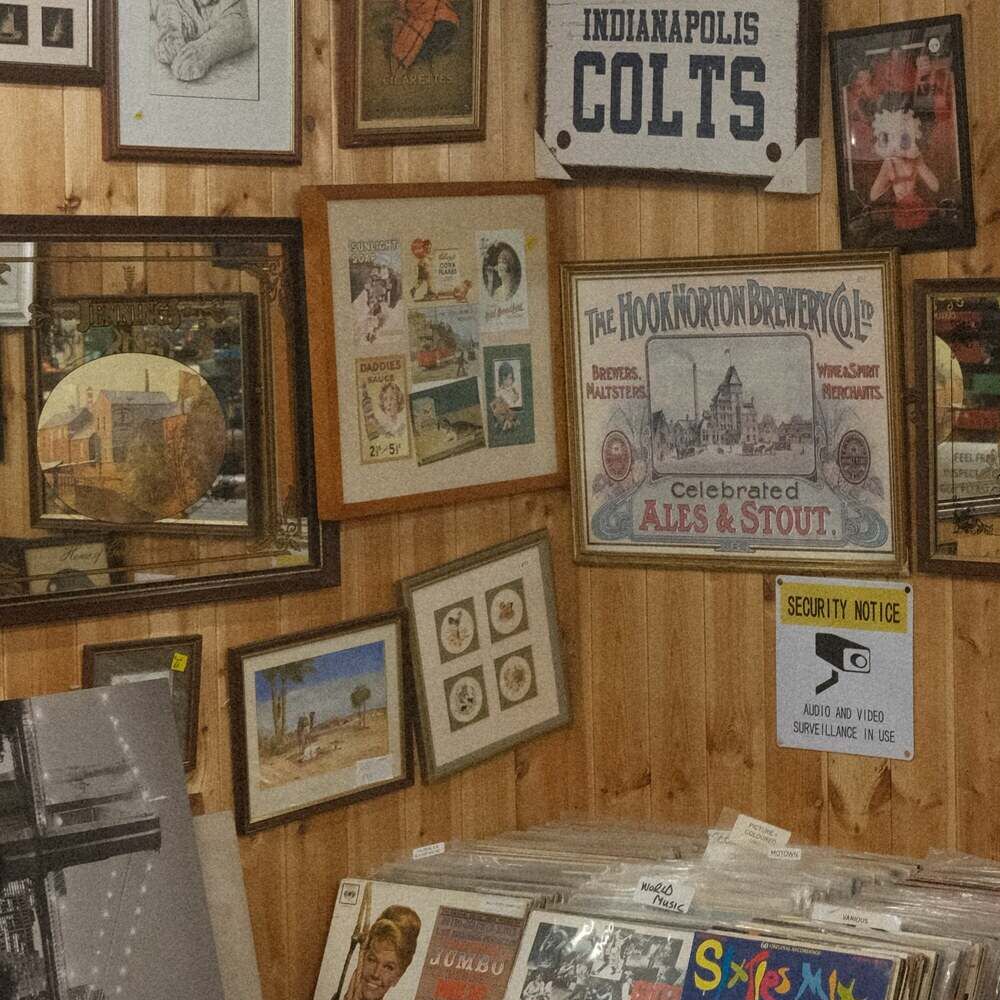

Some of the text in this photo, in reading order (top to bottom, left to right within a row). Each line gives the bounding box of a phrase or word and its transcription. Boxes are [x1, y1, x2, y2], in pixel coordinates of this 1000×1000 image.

[583, 8, 759, 45] INDIANAPOLIS
[573, 51, 766, 141] COLTS
[585, 307, 617, 345] THE
[617, 290, 674, 342] HOOK
[671, 283, 748, 335] NORTON
[746, 279, 834, 338] BREWERY
[671, 481, 800, 500] Celebrated
[638, 499, 709, 533] ALES
[715, 503, 737, 534] &
[788, 595, 901, 624] SECURITY NOTICE
[803, 703, 884, 723] AUDIO AND VIDEO
[793, 721, 895, 744] SURVEILLANCE IN USE
[771, 849, 799, 857] MOTOWN
[429, 950, 505, 976] JUMBO
